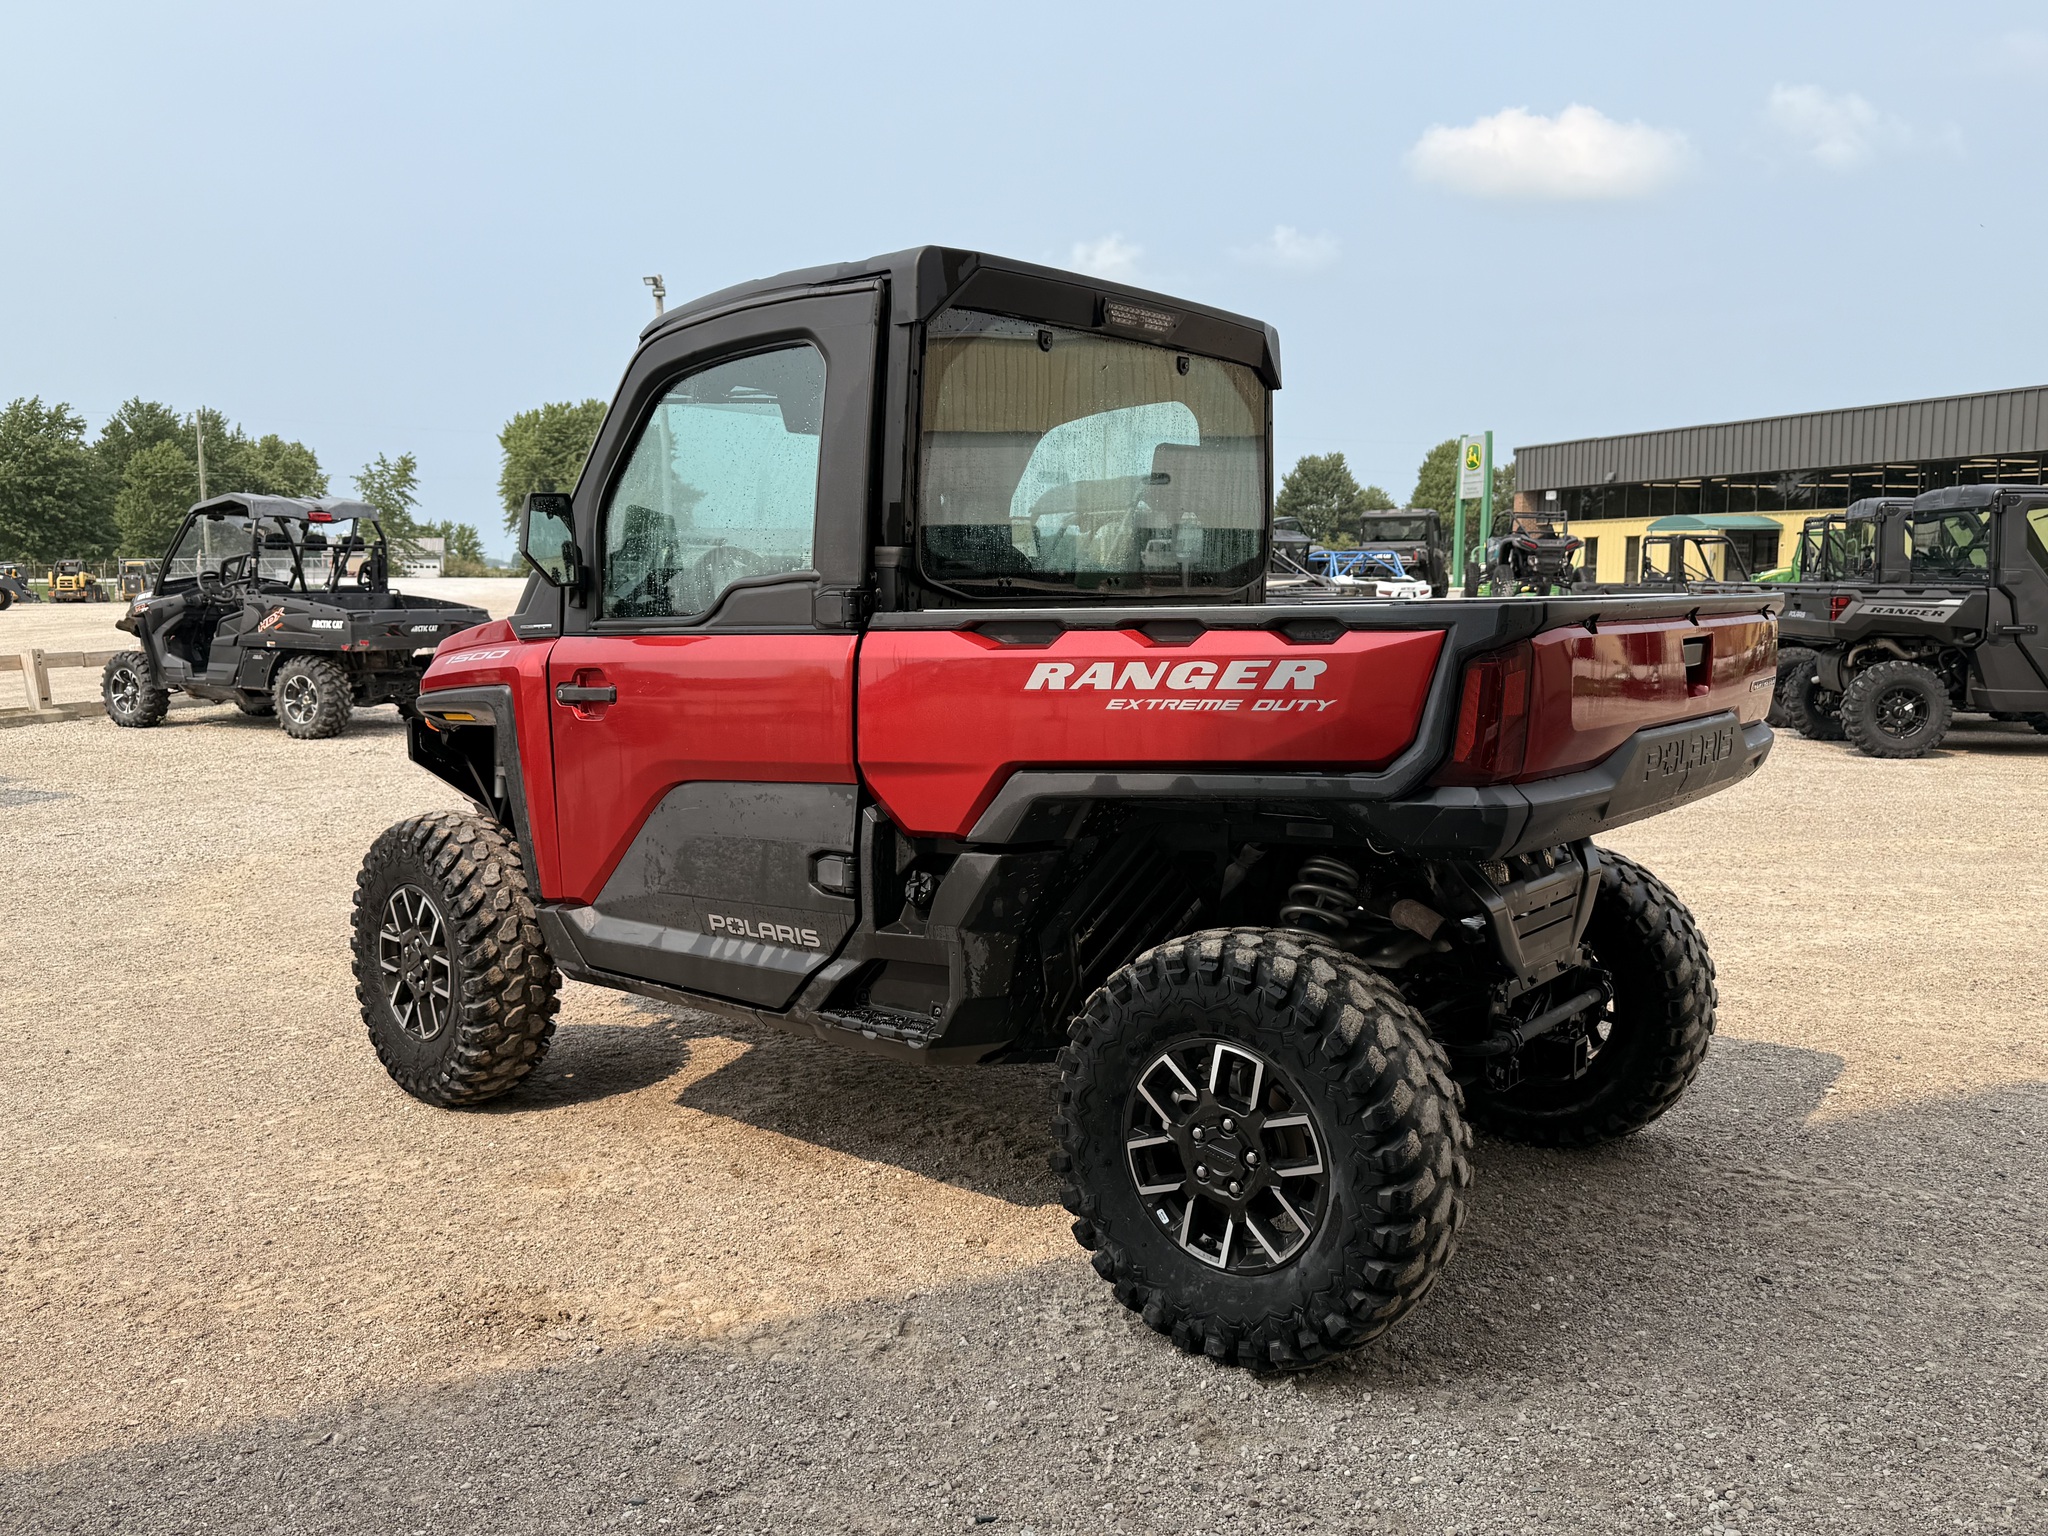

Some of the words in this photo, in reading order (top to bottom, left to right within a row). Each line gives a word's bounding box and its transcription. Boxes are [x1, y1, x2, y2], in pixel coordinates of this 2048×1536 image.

[258, 606, 285, 632] HDX
[311, 620, 331, 629] ARCTIC
[332, 620, 344, 629] CAT
[1869, 606, 1945, 617] RANGER
[445, 649, 510, 665] 1500
[1023, 659, 1328, 690] RANGER
[1105, 699, 1245, 711] EXTREME
[1250, 699, 1338, 712] DUTY
[1642, 726, 1734, 783] POLARIS
[707, 913, 820, 948] POLARIS
[1124, 1017, 1198, 1059] CROSS
